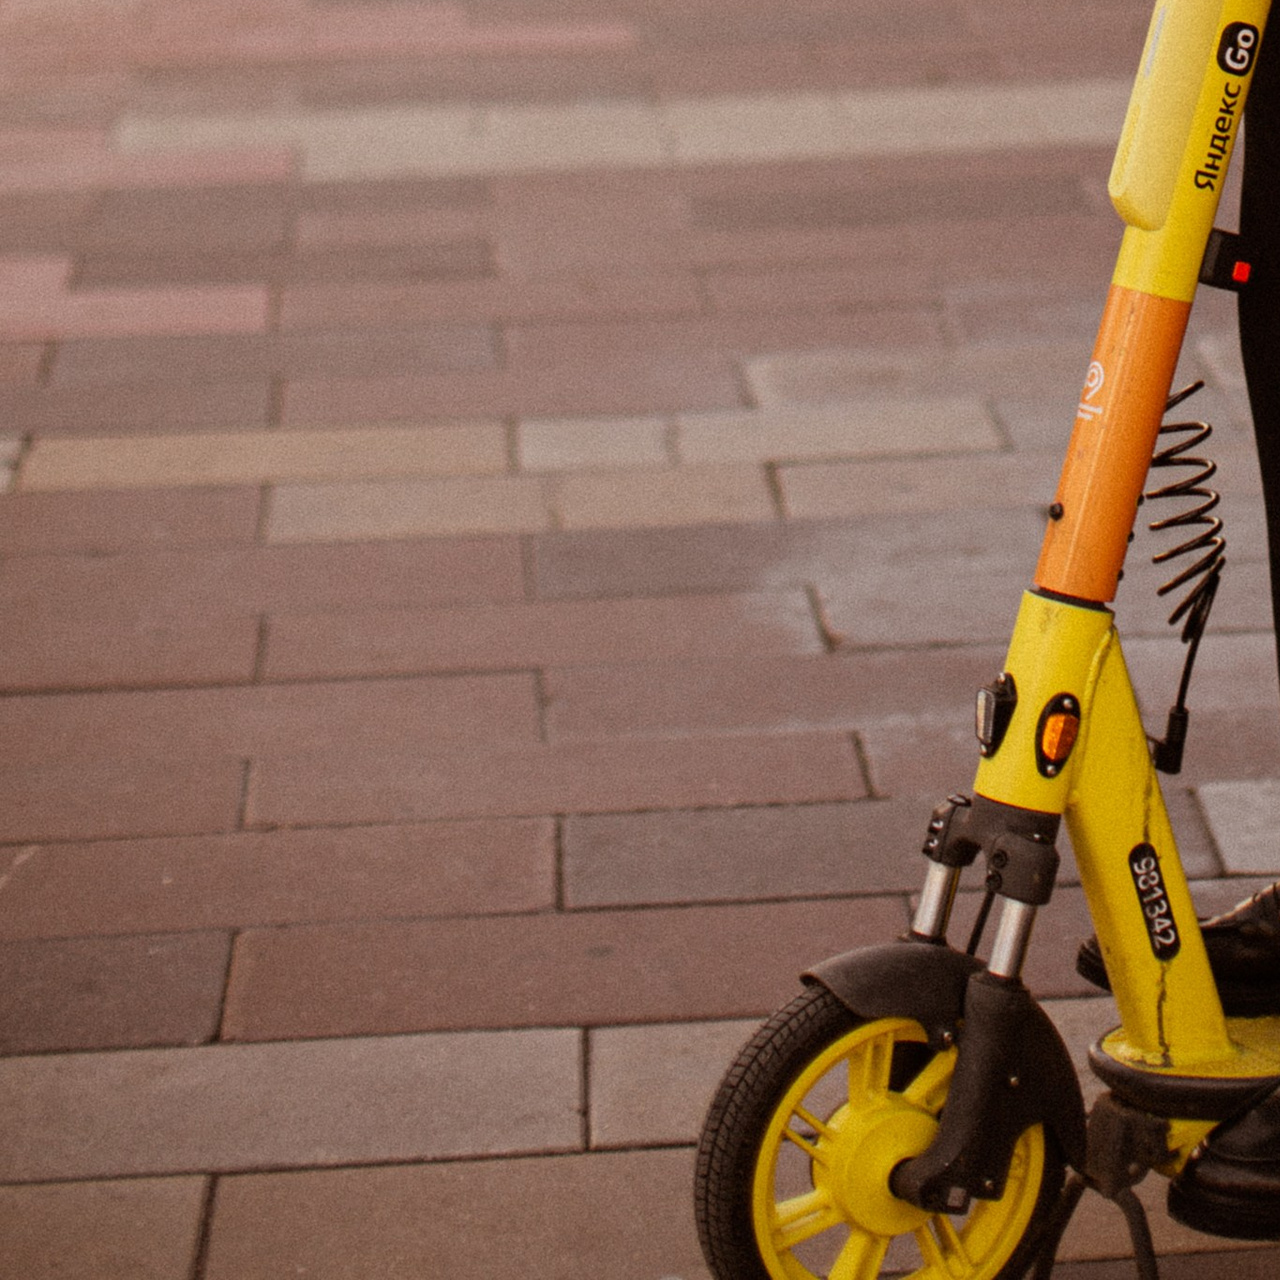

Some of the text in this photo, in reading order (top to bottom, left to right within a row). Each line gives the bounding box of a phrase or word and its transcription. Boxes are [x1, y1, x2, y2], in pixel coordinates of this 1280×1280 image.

[1194, 28, 1255, 192] Яндекс Go
[1133, 856, 1176, 949] 981342
